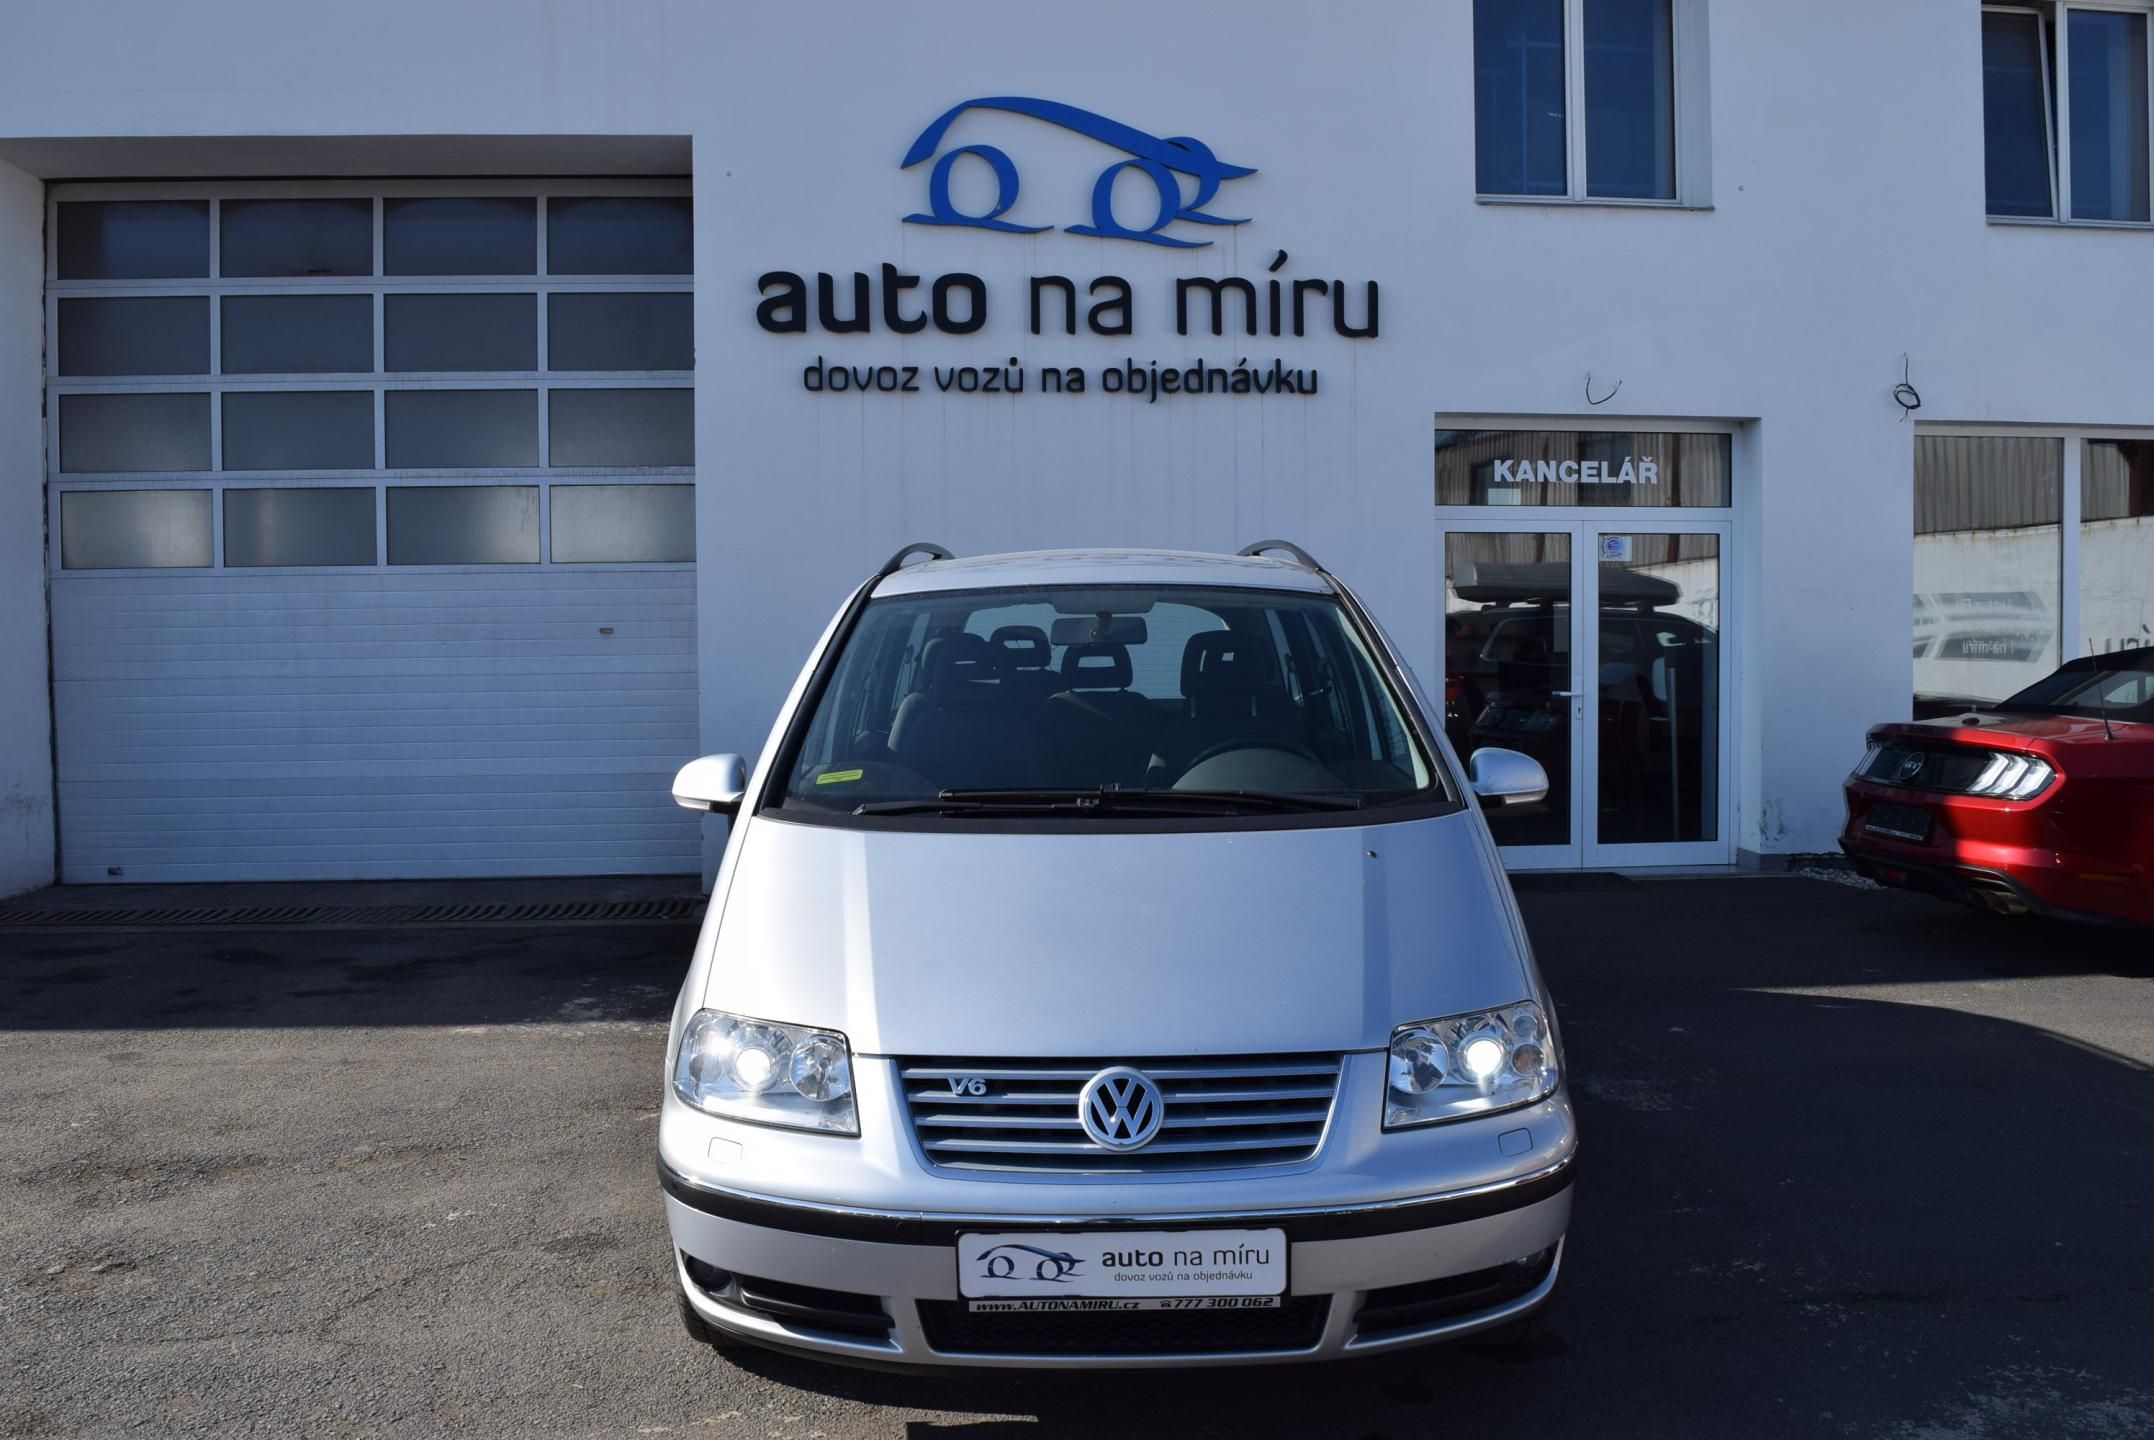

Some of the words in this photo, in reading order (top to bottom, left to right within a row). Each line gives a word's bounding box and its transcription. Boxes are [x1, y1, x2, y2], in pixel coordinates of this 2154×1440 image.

[756, 262, 987, 335] auto
[1030, 275, 1132, 336] na
[1176, 249, 1379, 338] míru
[803, 355, 920, 392] dovoz
[934, 356, 1024, 393] vozů
[1041, 367, 1085, 393] na
[1102, 357, 1318, 404] objednávku
[1493, 456, 1658, 485] KANCELÁŘ
[947, 1076, 988, 1096] V6
[1088, 1076, 1156, 1143] VW
[1102, 1249, 1163, 1267] auto
[1174, 1250, 1202, 1266] na
[1213, 1243, 1269, 1265] míru
[1114, 1272, 1146, 1282] dovoz
[1149, 1271, 1174, 1281] vozů
[1177, 1273, 1190, 1281] na
[1193, 1270, 1253, 1282] objednávku
[976, 1299, 1140, 1312] www.AUTONAMIRU.cz
[1174, 1299, 1202, 1308] 777
[1206, 1298, 1239, 1308] 300
[1241, 1297, 1274, 1307] 062
